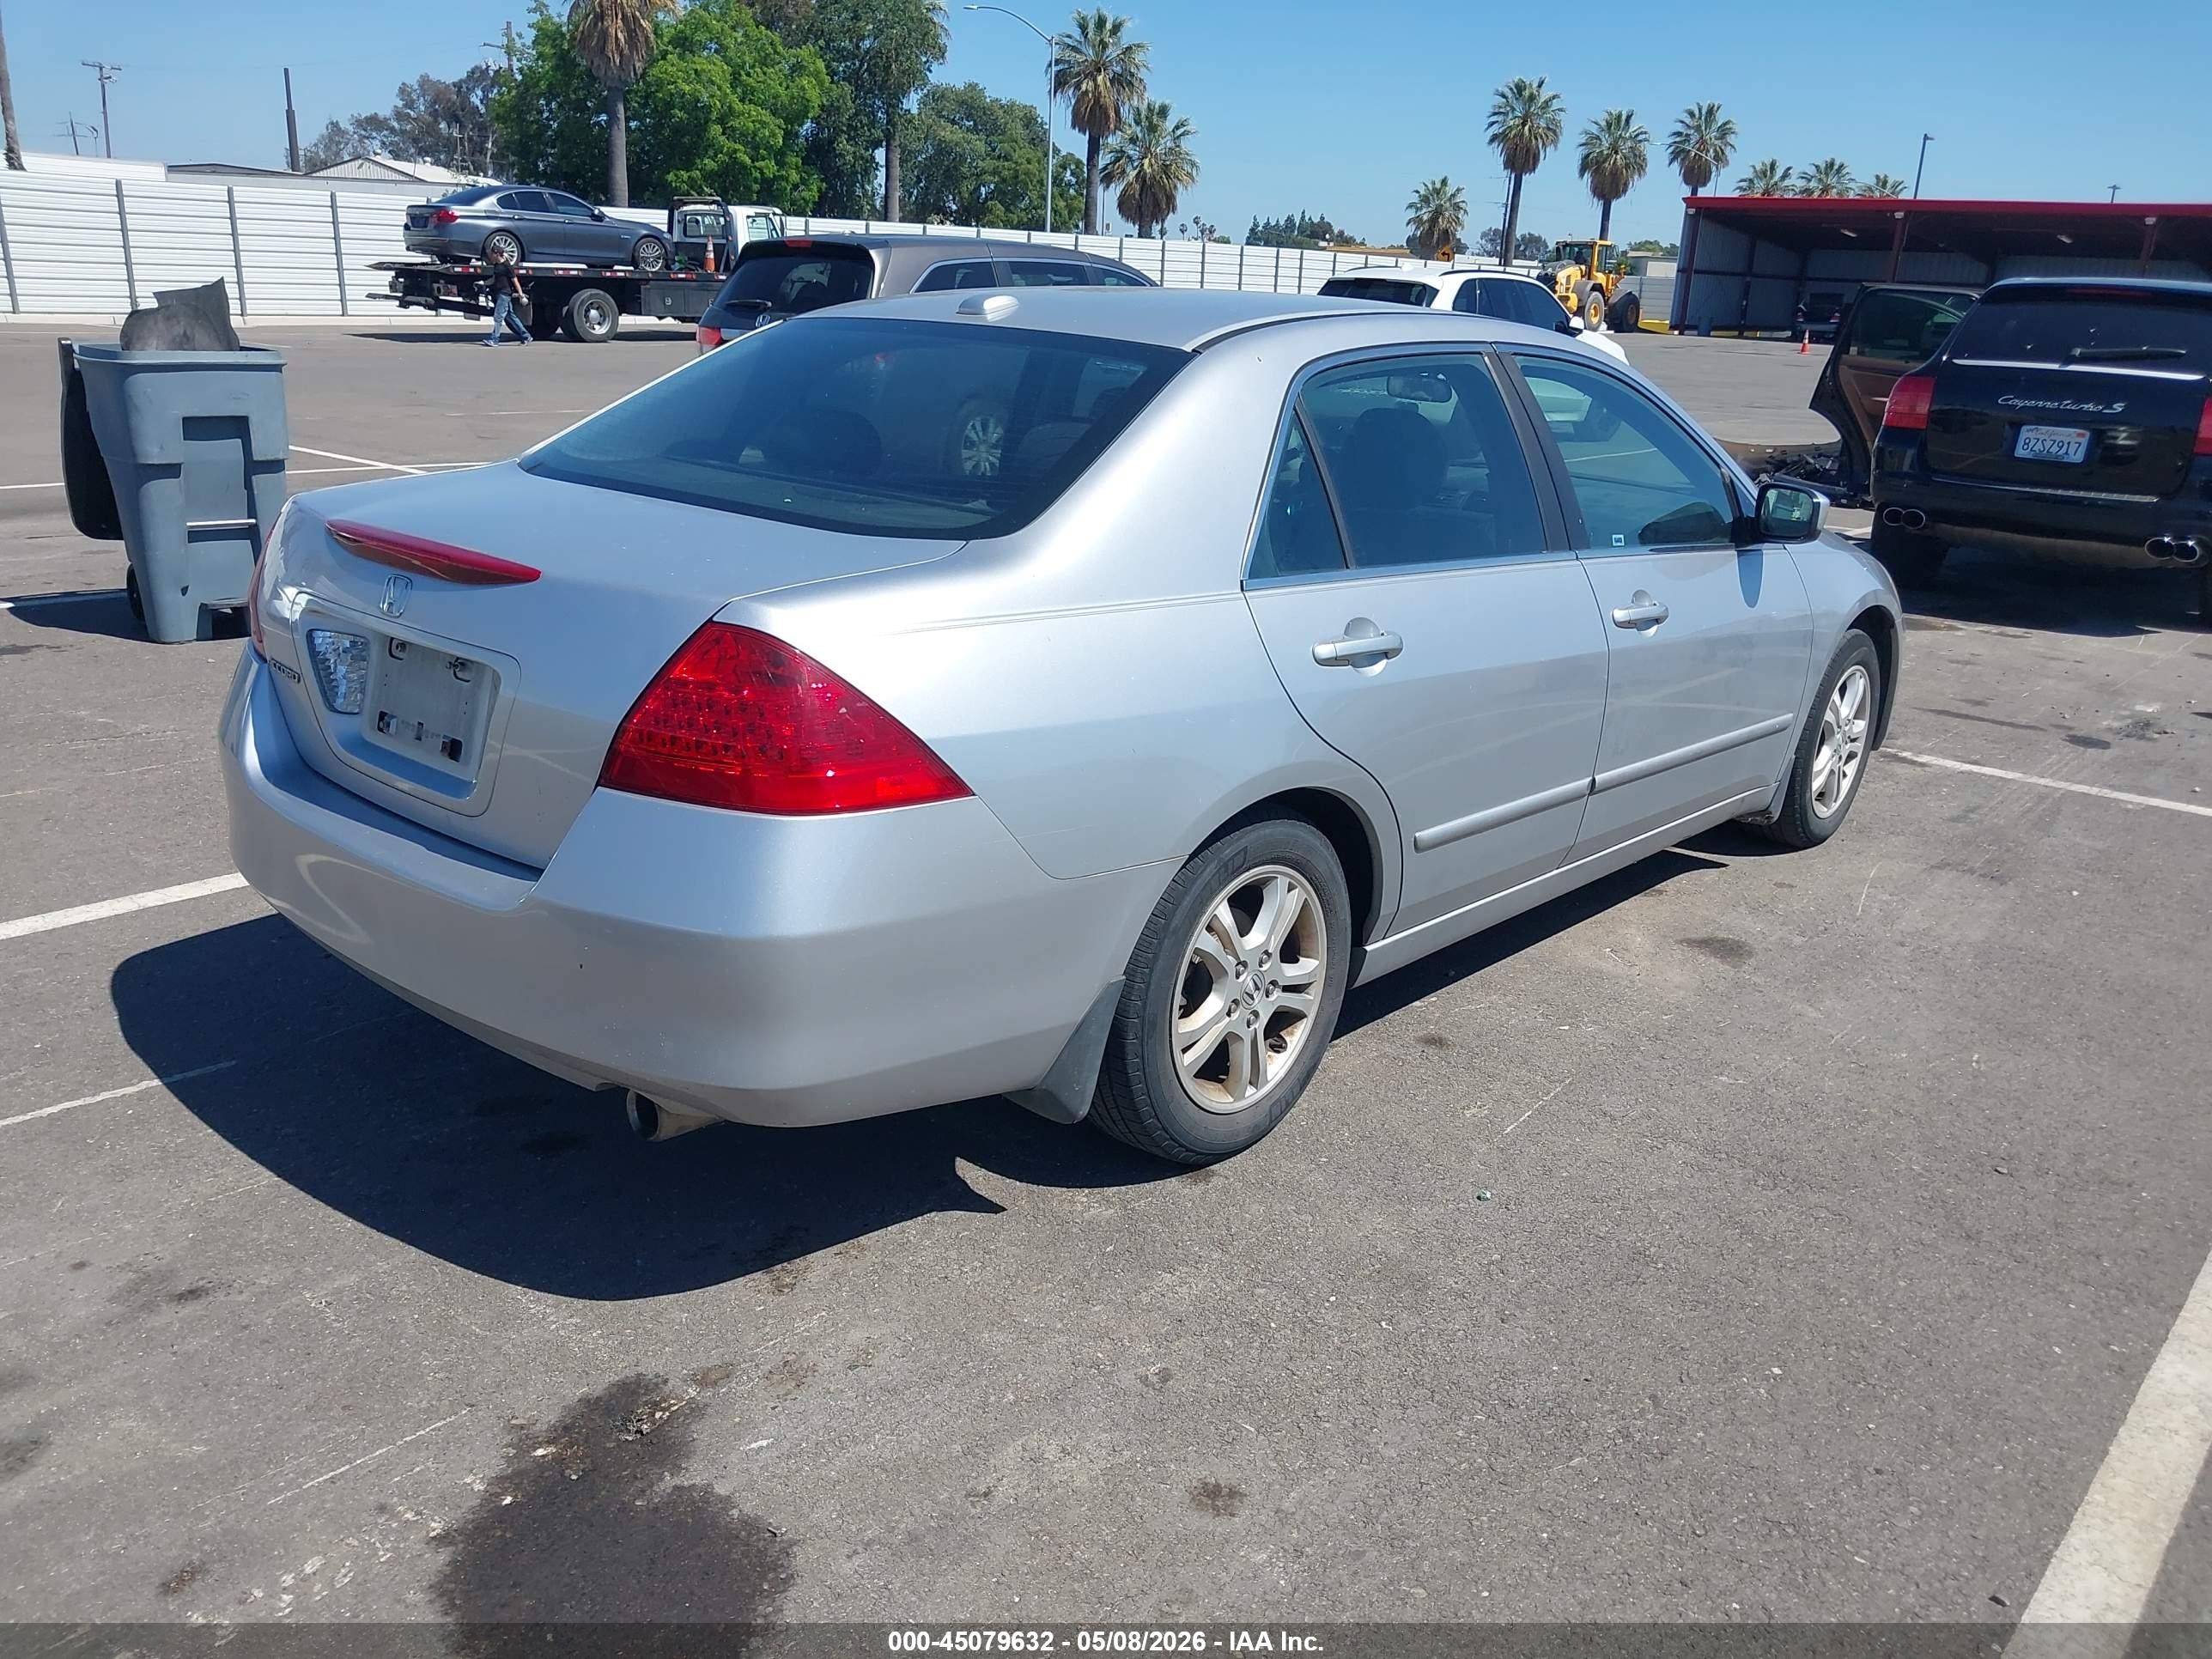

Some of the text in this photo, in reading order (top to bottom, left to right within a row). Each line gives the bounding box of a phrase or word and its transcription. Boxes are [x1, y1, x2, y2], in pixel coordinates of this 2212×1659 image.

[1998, 396, 2058, 410] Cayenne
[2102, 403, 2127, 413] S
[2022, 437, 2082, 456] 8ZSZ917
